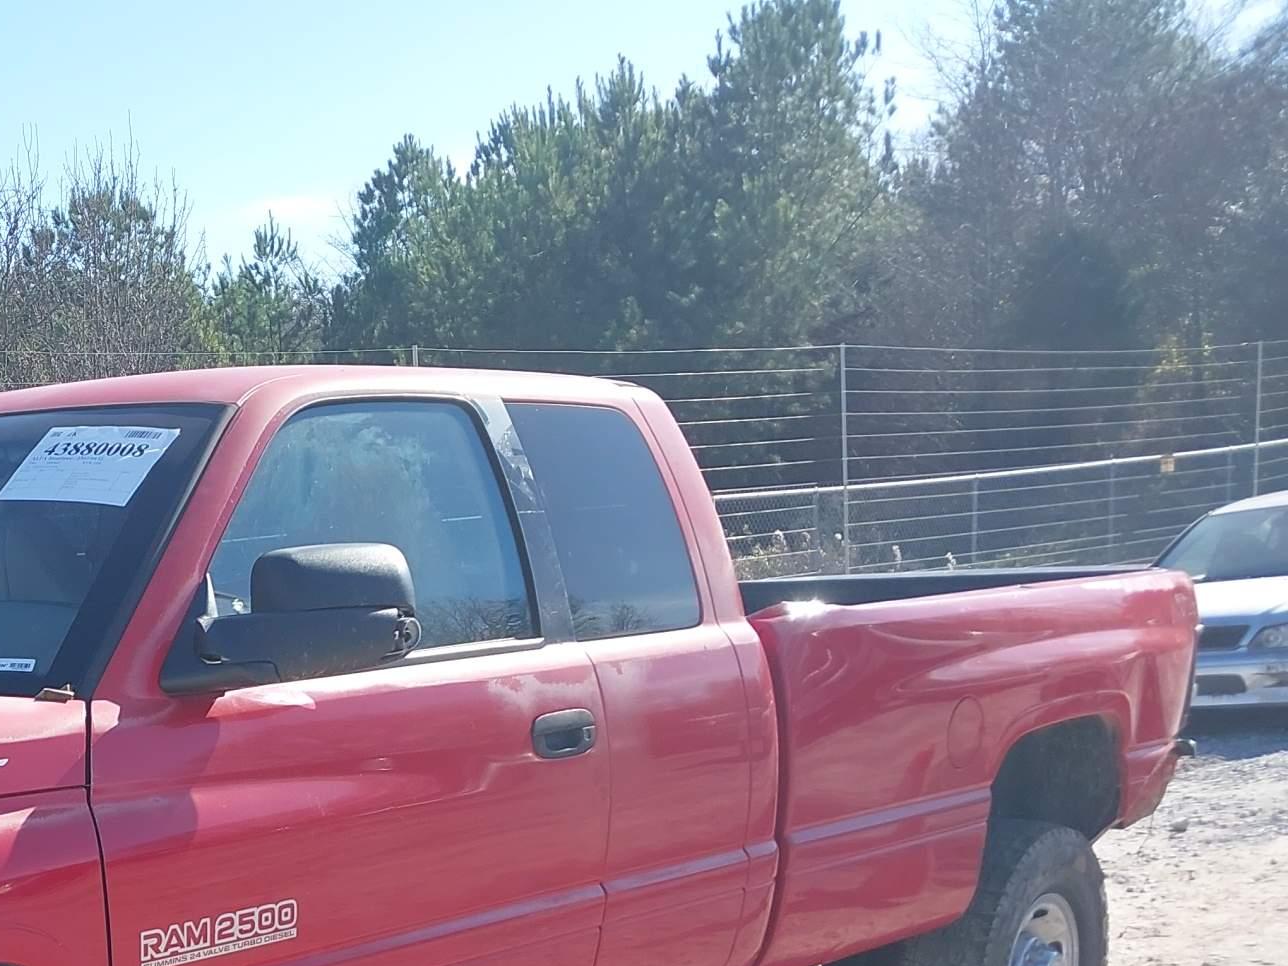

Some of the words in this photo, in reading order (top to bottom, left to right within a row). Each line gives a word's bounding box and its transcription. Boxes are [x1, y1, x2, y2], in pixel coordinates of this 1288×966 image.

[43, 442, 151, 458] 43880008
[140, 917, 211, 962] RAM
[214, 899, 297, 945] 2500
[189, 952, 202, 961] 24
[203, 945, 232, 957] VALVE
[233, 938, 263, 950] TURBO
[263, 931, 296, 943] DIESEL
